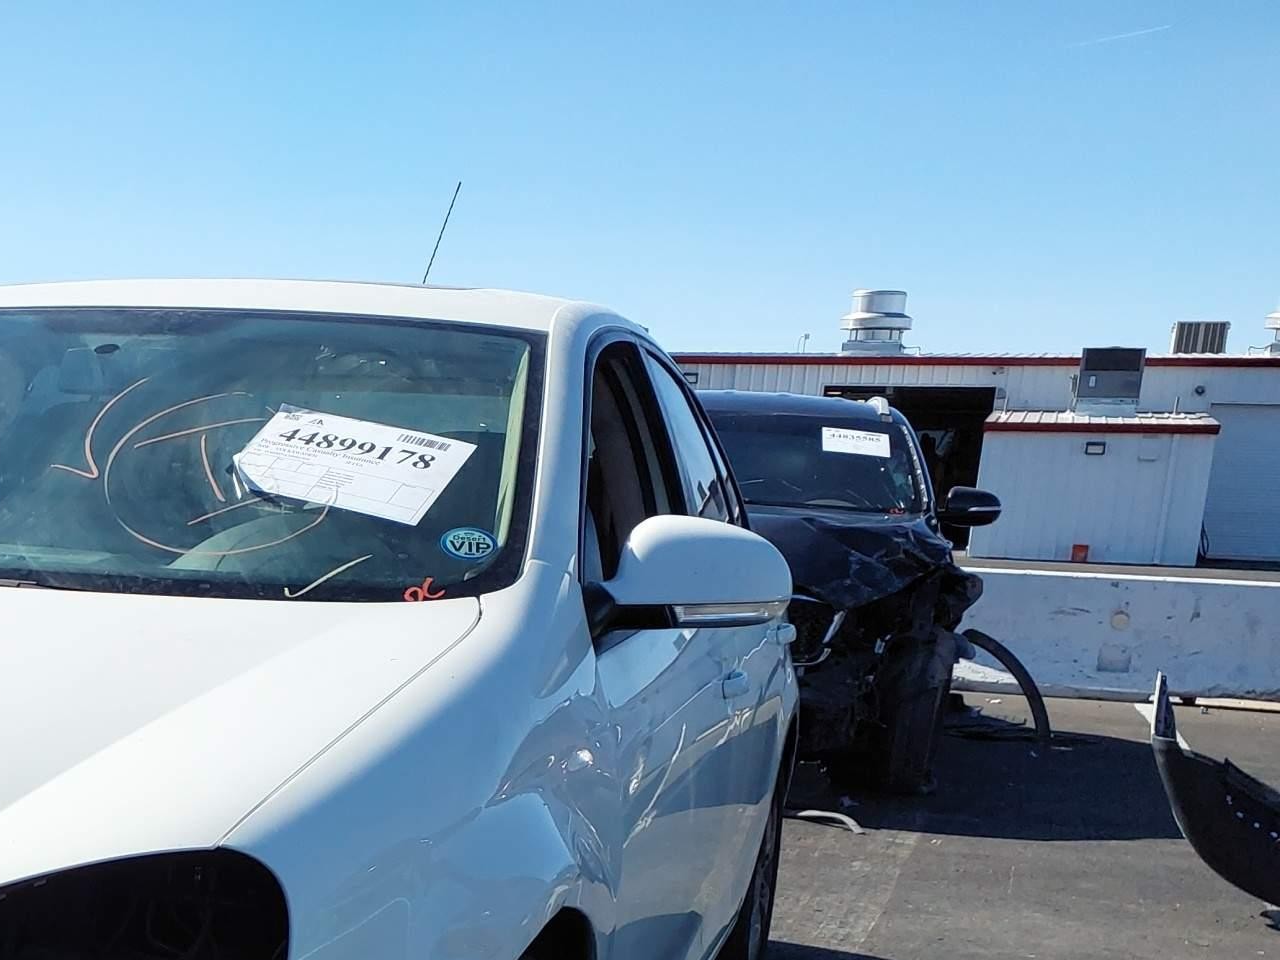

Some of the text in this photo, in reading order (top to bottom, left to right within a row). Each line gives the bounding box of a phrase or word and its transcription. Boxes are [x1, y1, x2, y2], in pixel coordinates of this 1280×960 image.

[279, 428, 436, 470] 44899178
[453, 534, 486, 542] Desert
[449, 540, 491, 554] VIP
